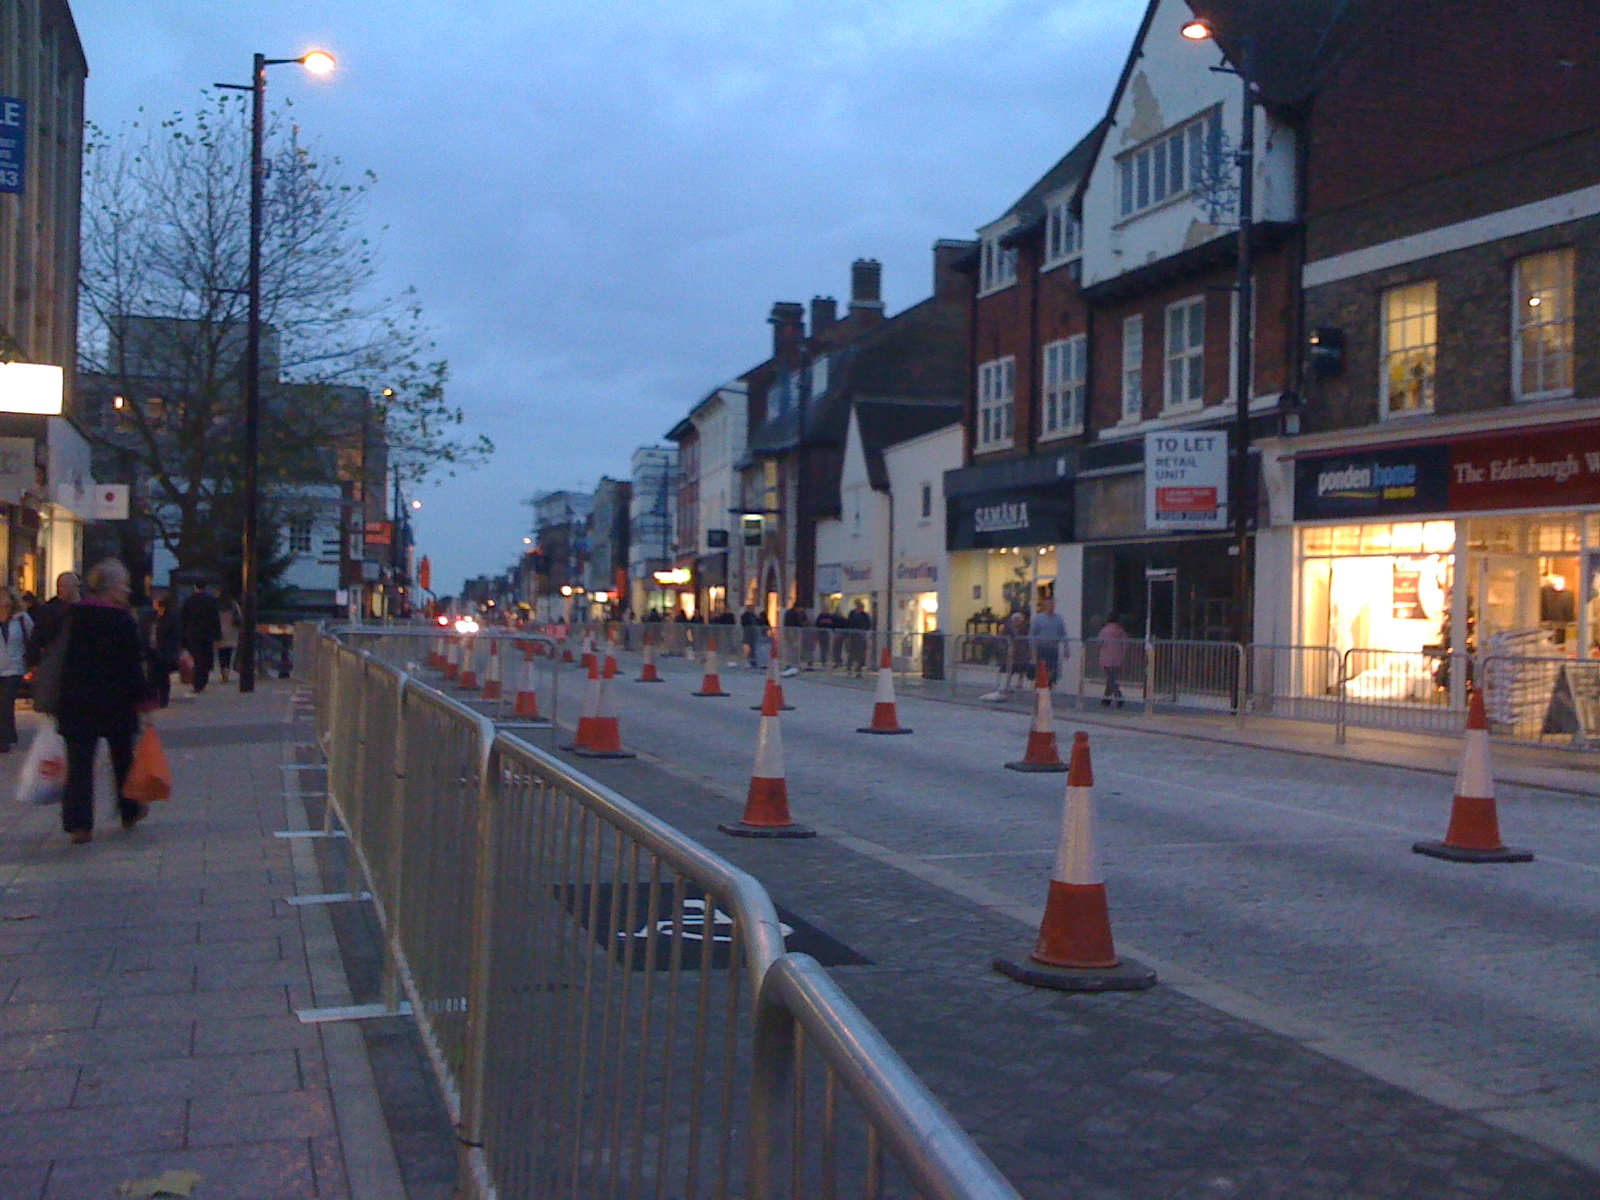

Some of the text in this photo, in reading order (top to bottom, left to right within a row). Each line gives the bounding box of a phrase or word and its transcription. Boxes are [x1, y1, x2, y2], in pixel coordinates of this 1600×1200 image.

[1155, 436, 1216, 452] TO LET
[1155, 456, 1198, 468] RETAIL
[1453, 462, 1483, 485] The
[1489, 453, 1580, 483] Edinburgh
[1155, 469, 1186, 481] UNIT
[1317, 462, 1418, 497] ponden home
